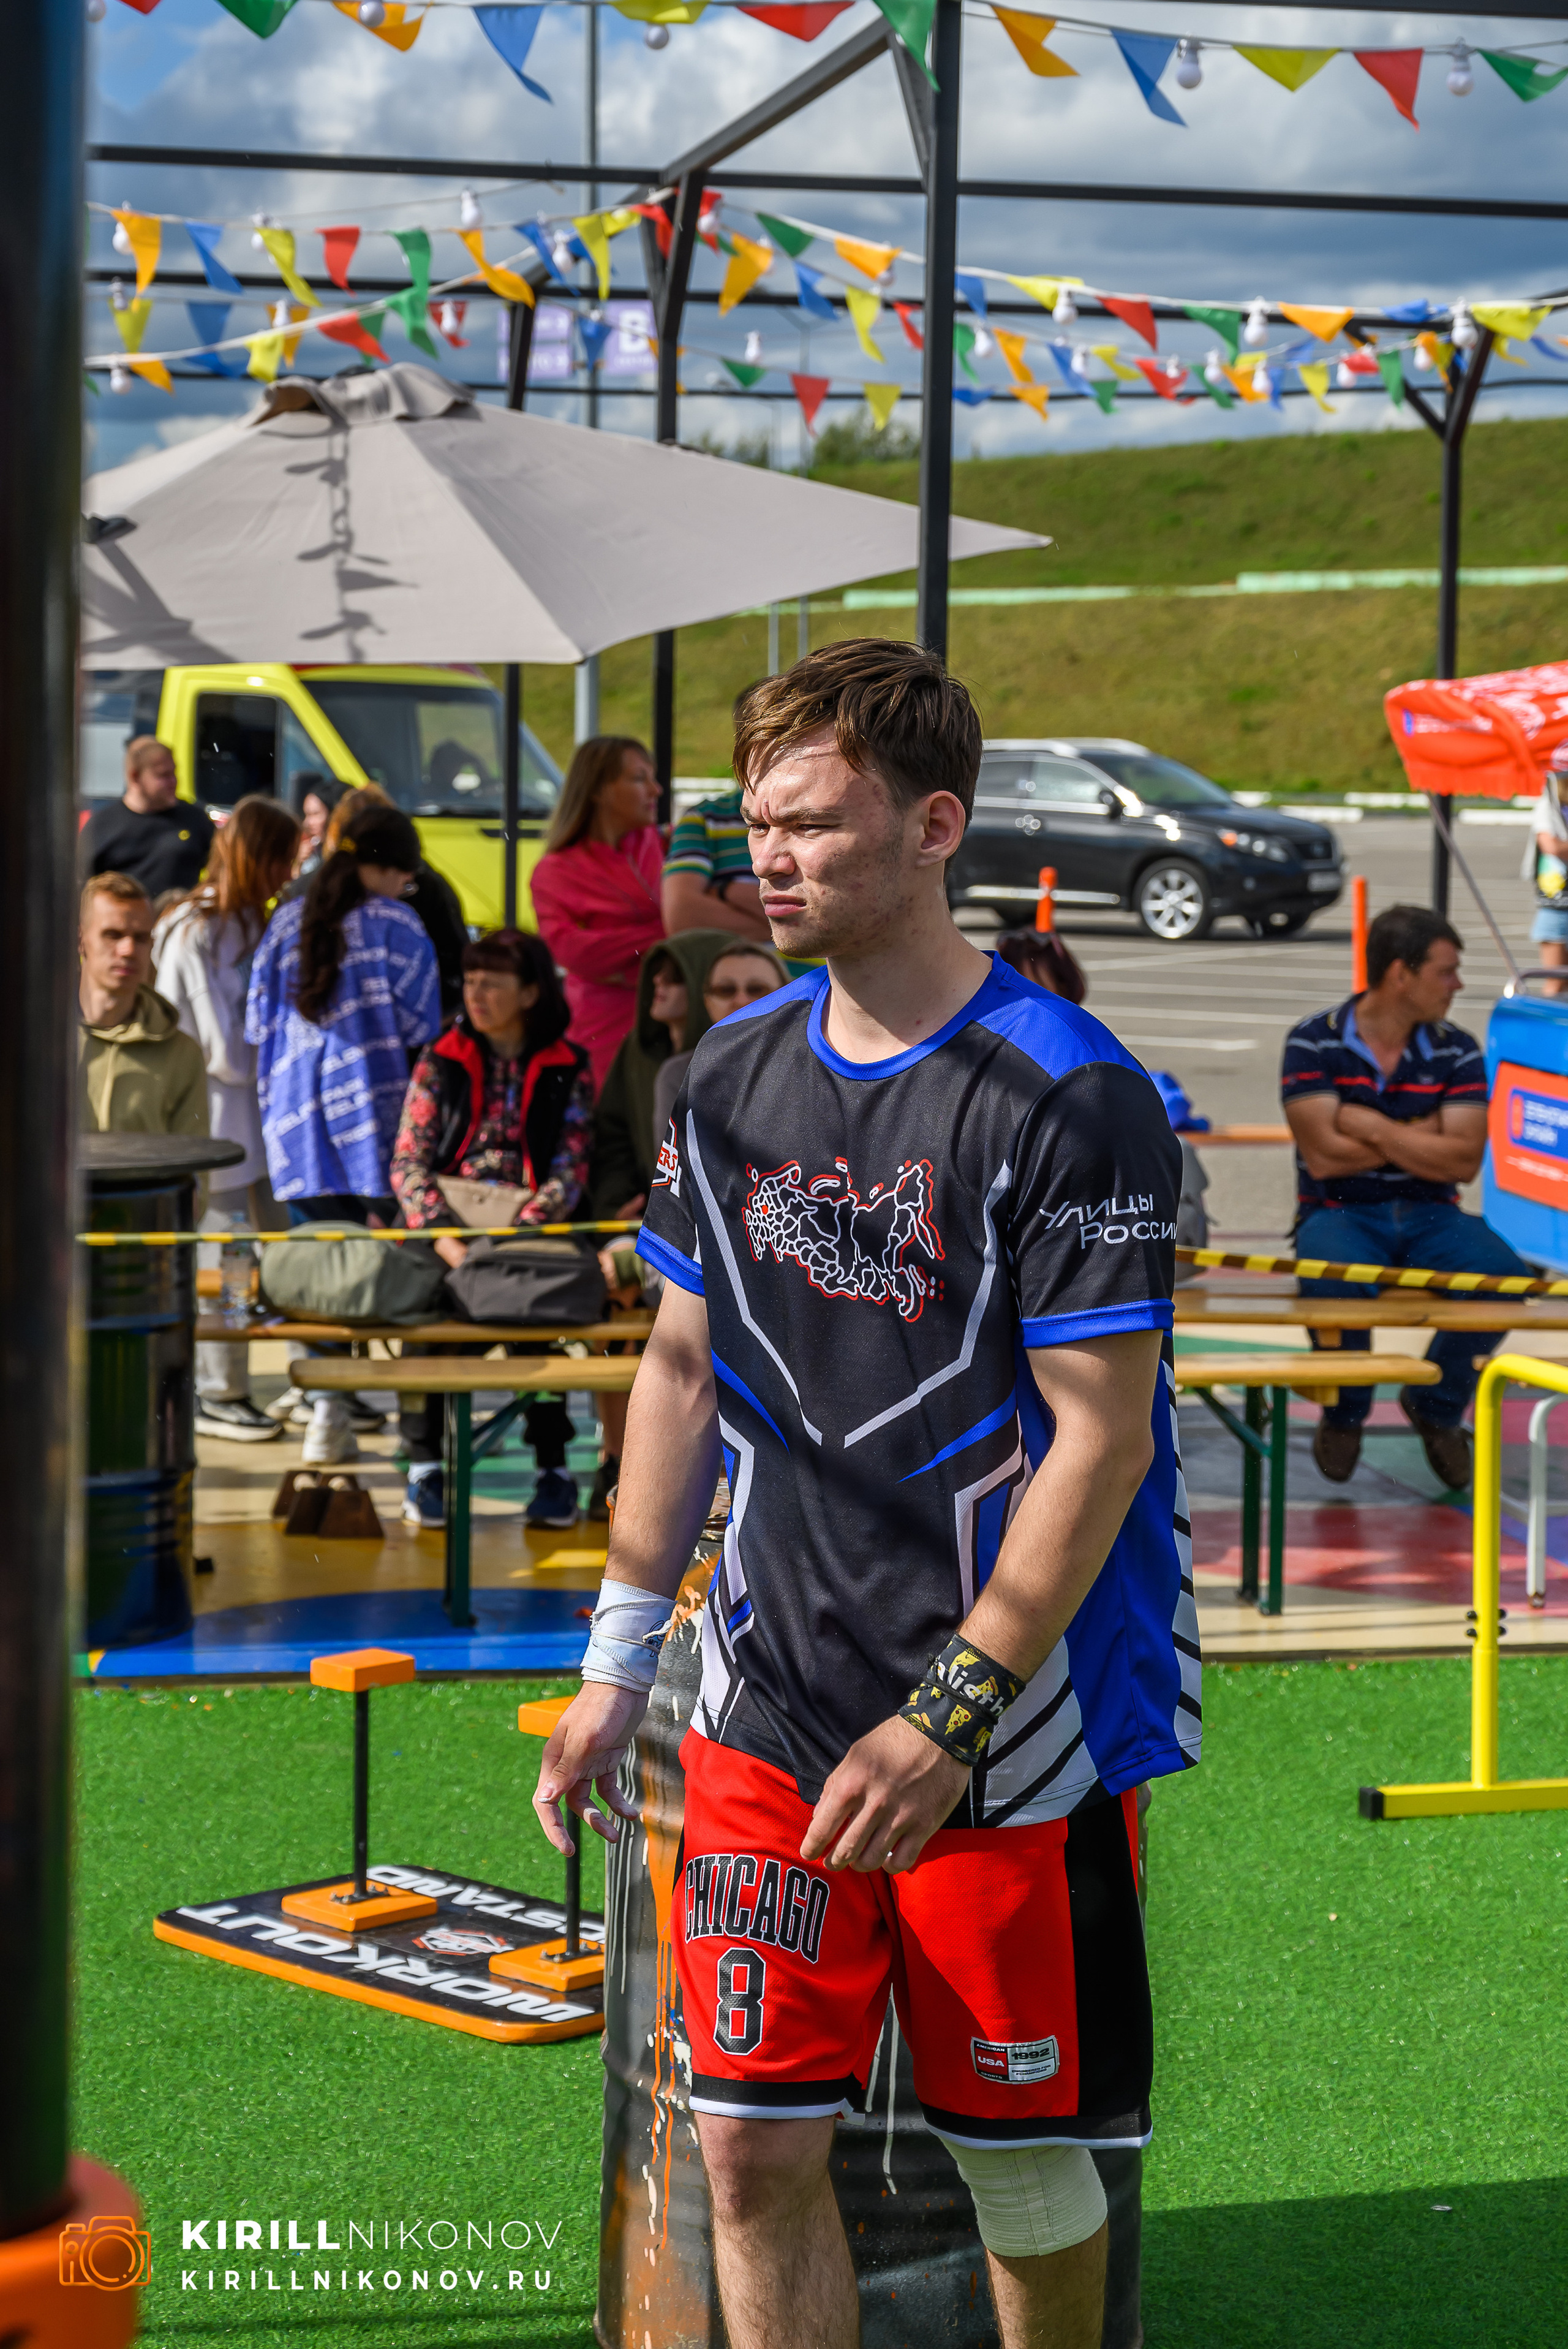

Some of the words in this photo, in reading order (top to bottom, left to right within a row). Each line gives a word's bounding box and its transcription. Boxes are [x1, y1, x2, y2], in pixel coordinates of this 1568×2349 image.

[1039, 1194, 1153, 1229] УЛИЦЫ
[685, 1854, 830, 1964] CHICAGO
[176, 1904, 596, 2023] WORKOUT
[713, 1947, 766, 2056] 8
[976, 2043, 1005, 2052] AMERICAN
[978, 2056, 1005, 2067] USA
[1011, 2048, 1050, 2060] 1992
